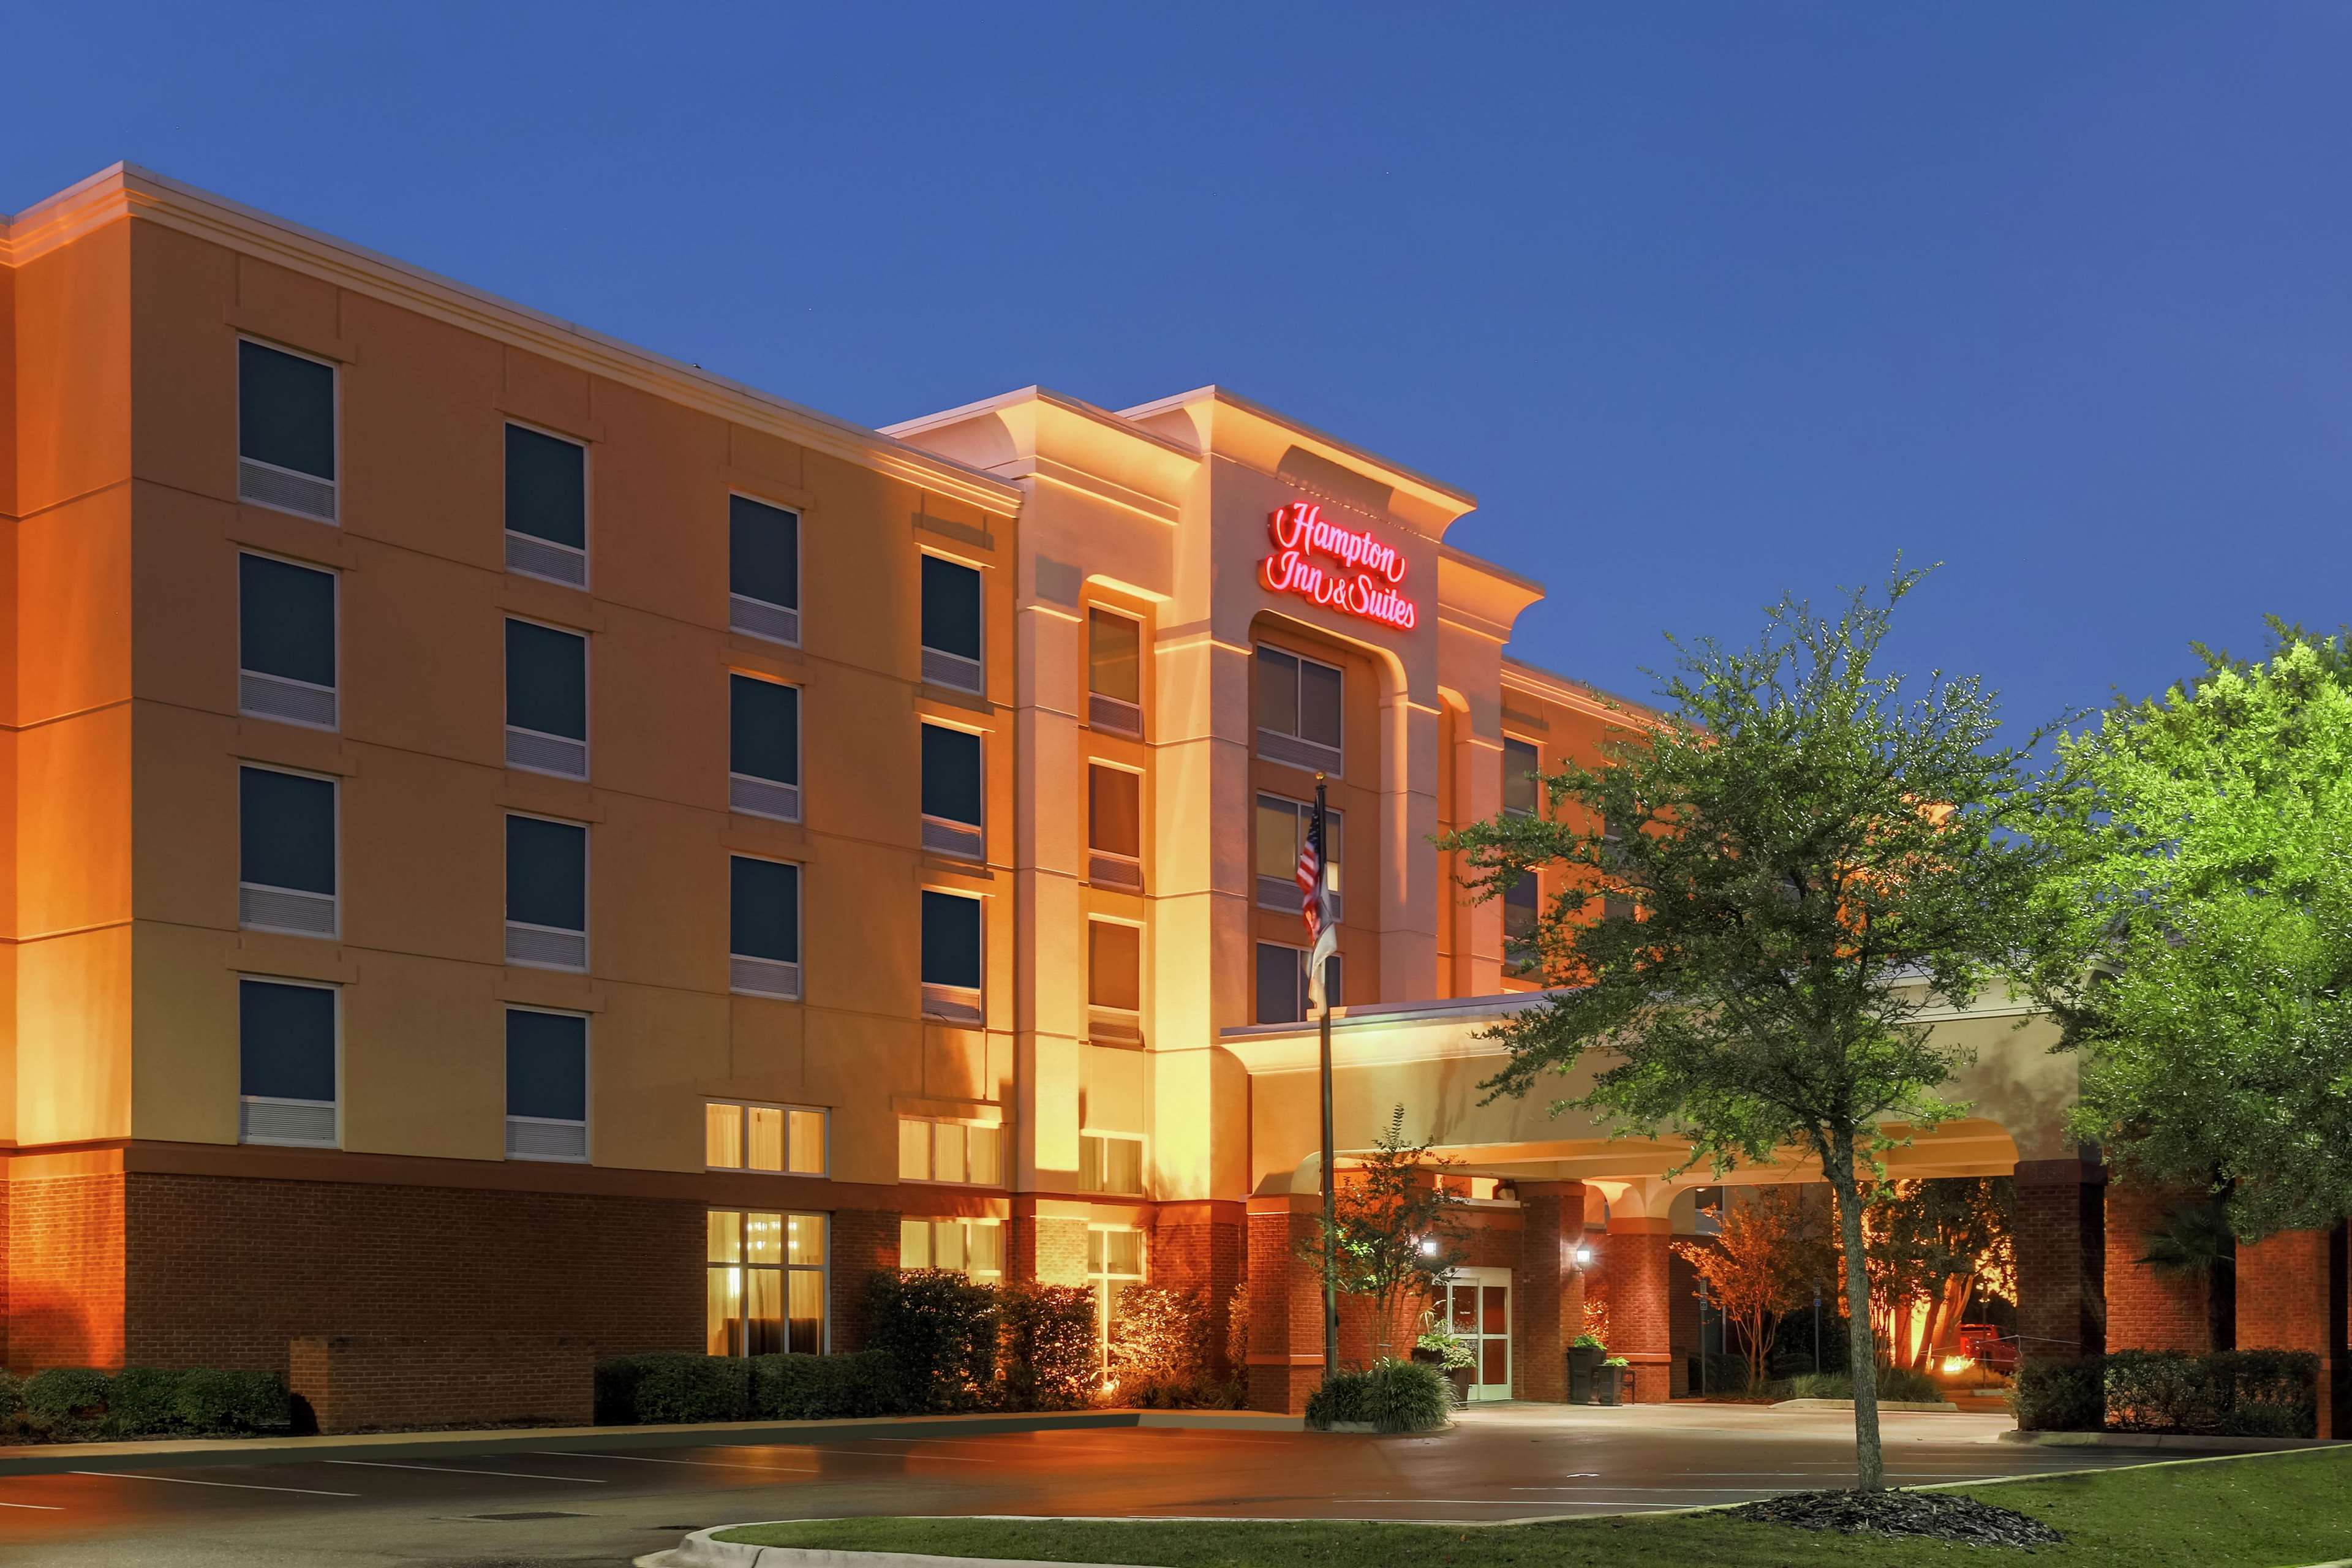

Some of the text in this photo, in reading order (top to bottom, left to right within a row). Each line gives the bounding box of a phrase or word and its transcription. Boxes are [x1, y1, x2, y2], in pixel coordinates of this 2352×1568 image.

[1275, 502, 1406, 584] Hampton
[1265, 550, 1415, 629] Inn & Suites
